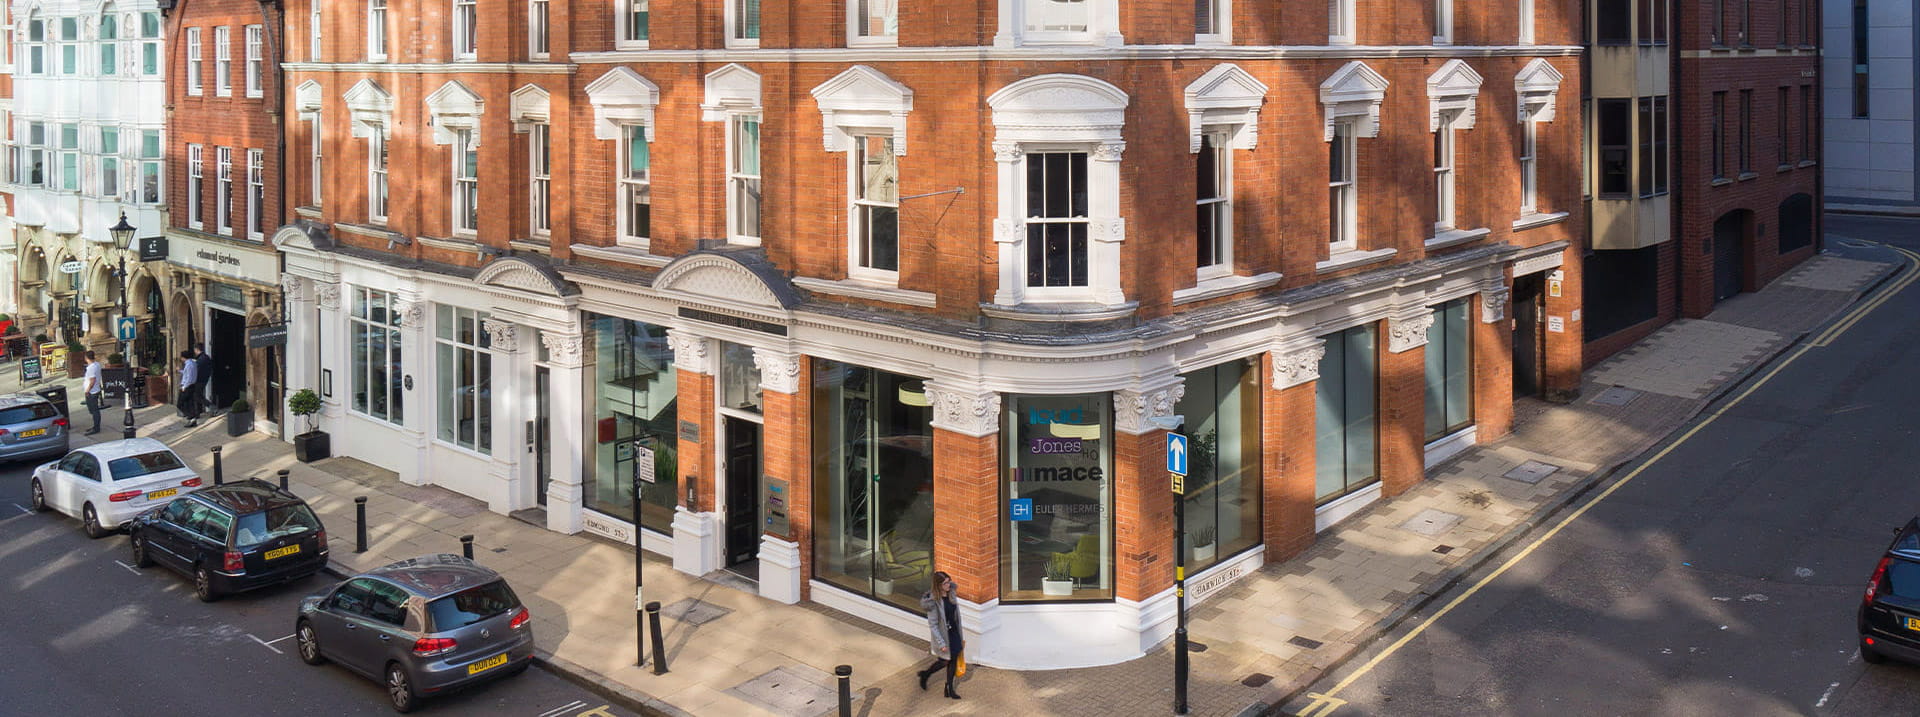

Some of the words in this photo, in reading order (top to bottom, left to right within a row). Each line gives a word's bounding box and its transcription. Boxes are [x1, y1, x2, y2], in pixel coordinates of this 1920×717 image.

[1031, 439, 1082, 453] Jones
[1034, 466, 1103, 481] mace
[1172, 475, 1182, 492] H
[1035, 504, 1063, 514] EULER
[1067, 503, 1105, 514] HERMES
